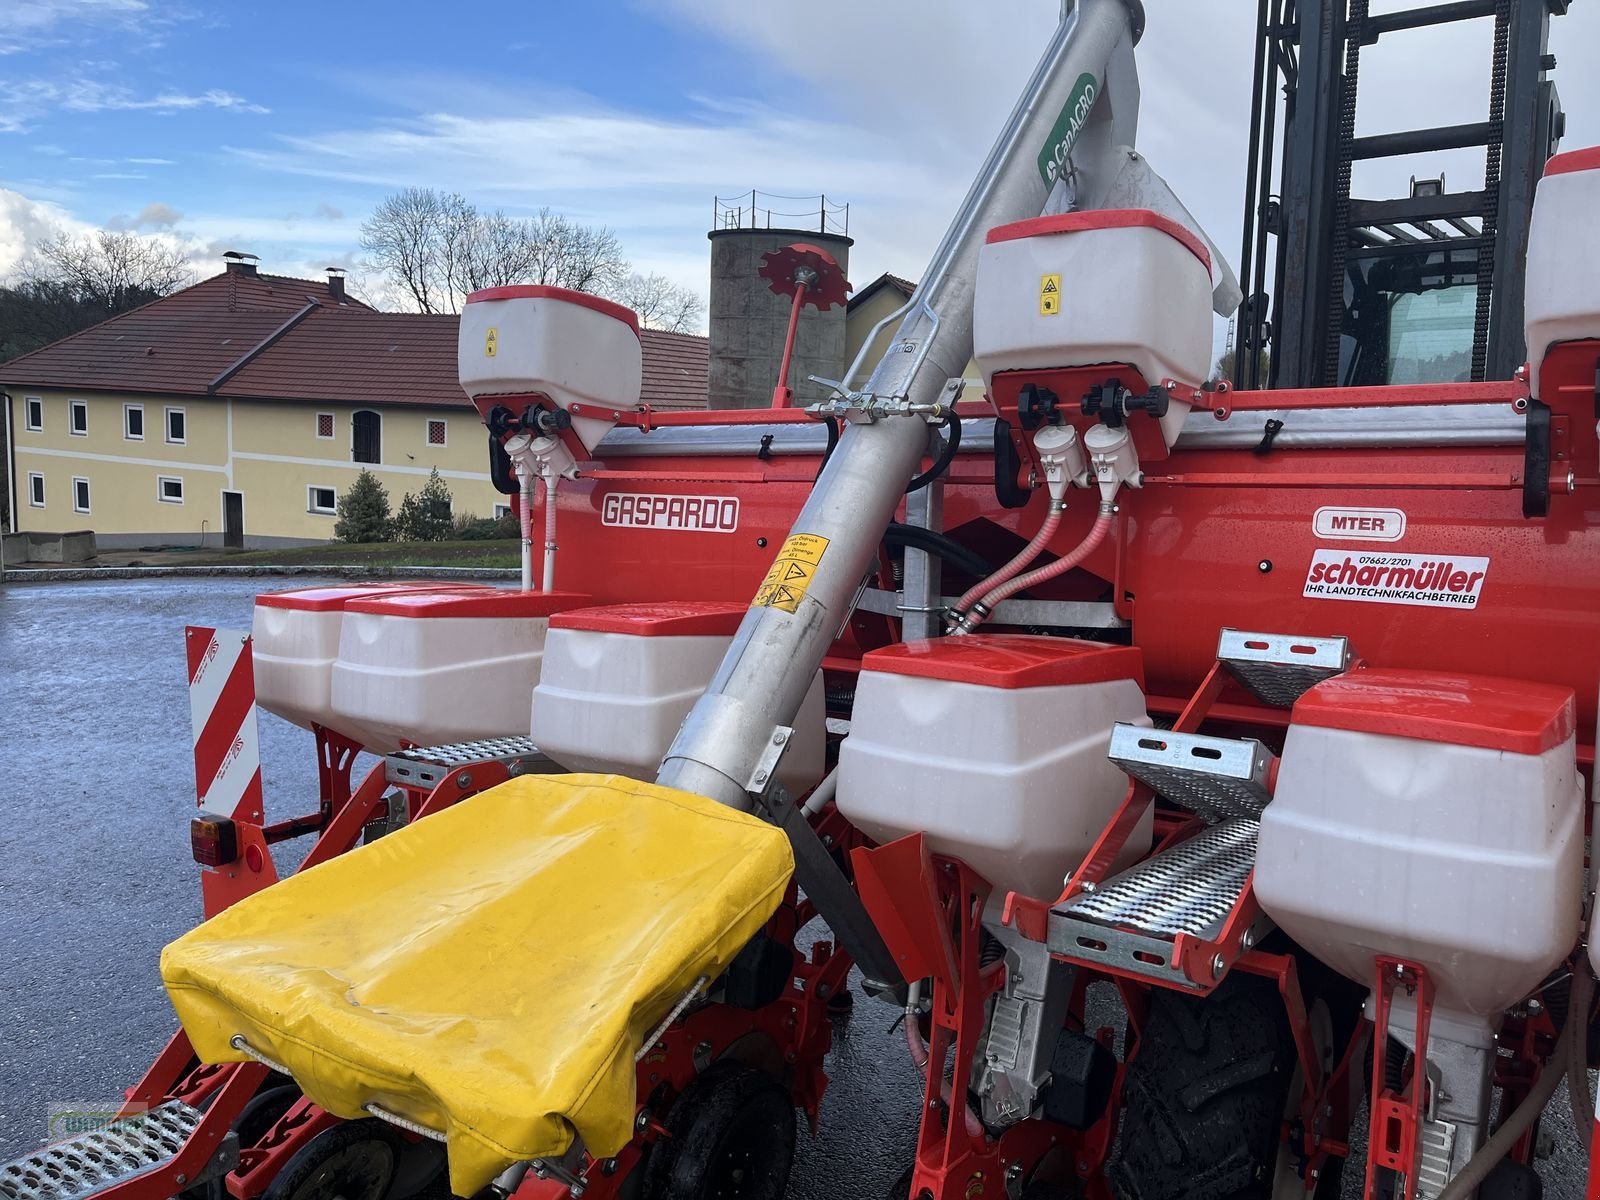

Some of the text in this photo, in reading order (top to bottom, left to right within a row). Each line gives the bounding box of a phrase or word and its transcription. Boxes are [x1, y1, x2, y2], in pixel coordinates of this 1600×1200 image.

[1054, 84, 1095, 166] CanAGRO
[603, 496, 738, 530] GASPARDO
[1331, 516, 1386, 532] MTER
[1309, 557, 1484, 593] scharmüller
[1358, 556, 1412, 567] 07662/2701
[1305, 584, 1477, 605] IHR LANDTECHNIKFACHBETRIEB
